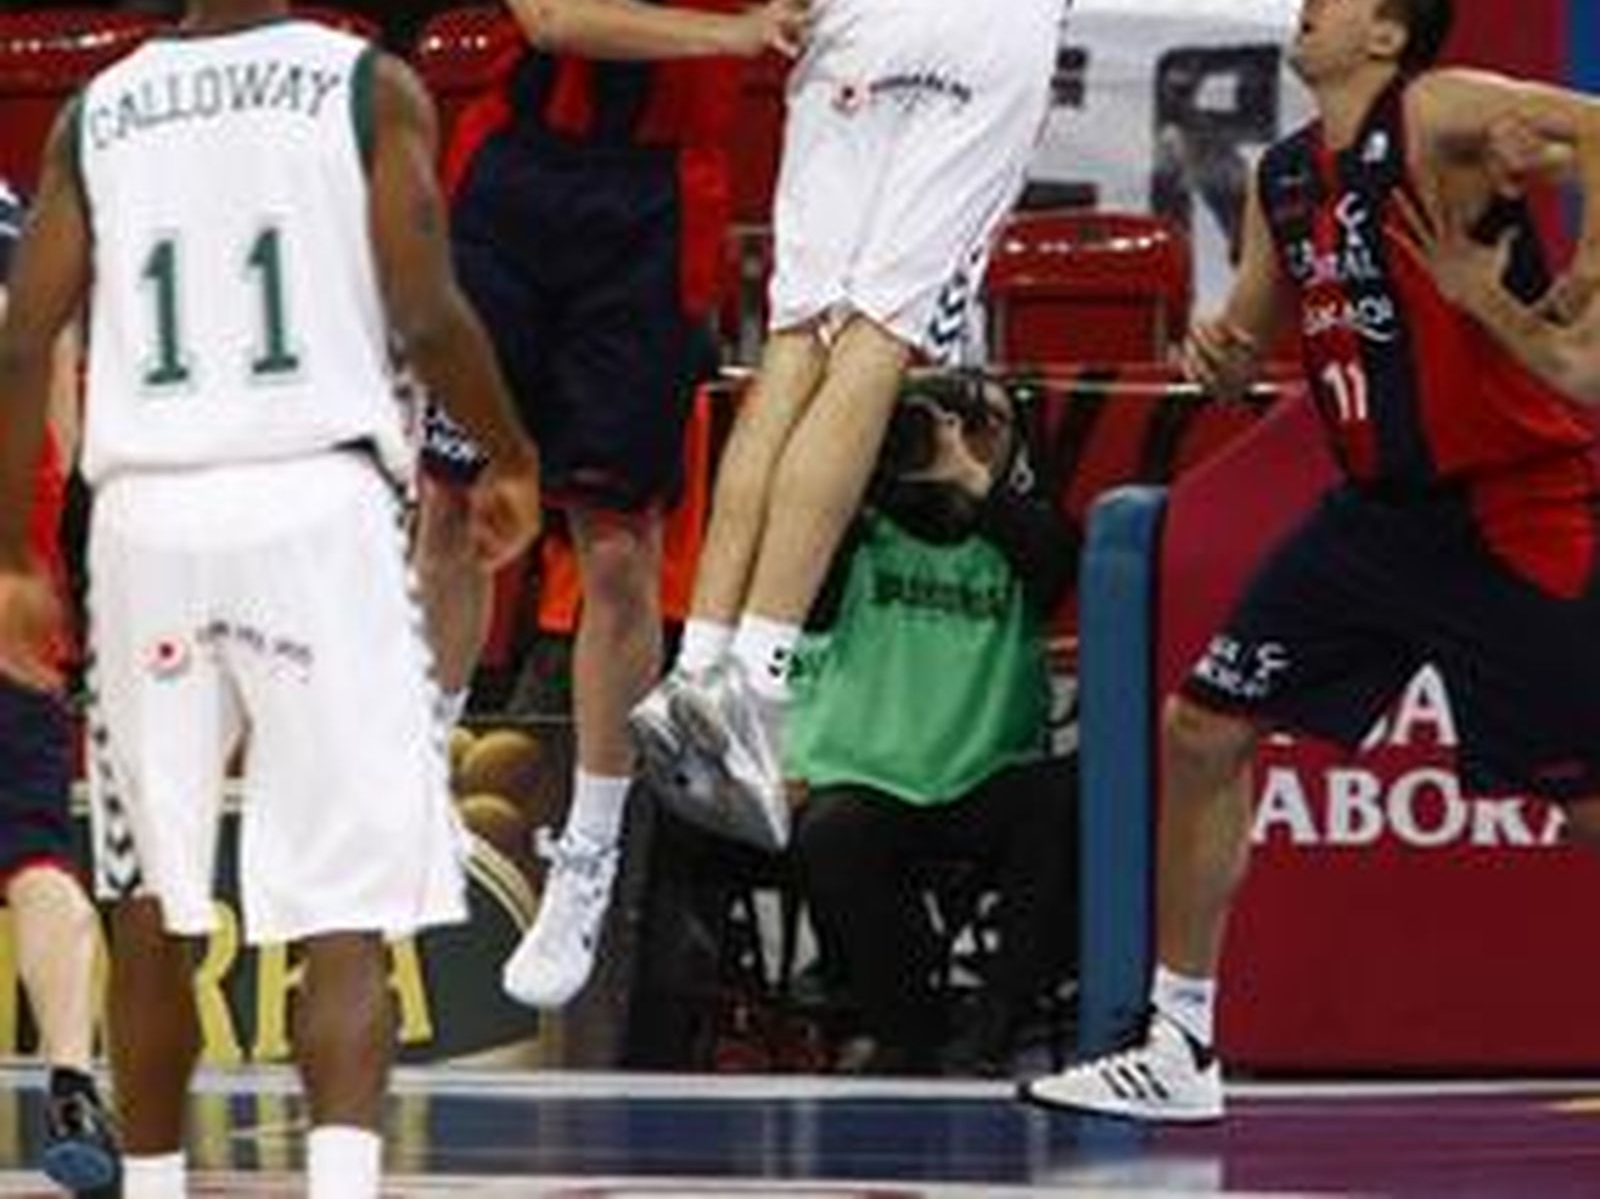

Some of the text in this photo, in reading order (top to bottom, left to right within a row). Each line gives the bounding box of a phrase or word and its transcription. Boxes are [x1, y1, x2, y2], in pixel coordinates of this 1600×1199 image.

[89, 61, 342, 149] CALLOWAY
[140, 226, 300, 387] 11
[1321, 360, 1367, 421] 11
[1250, 768, 1568, 846] ABOR
